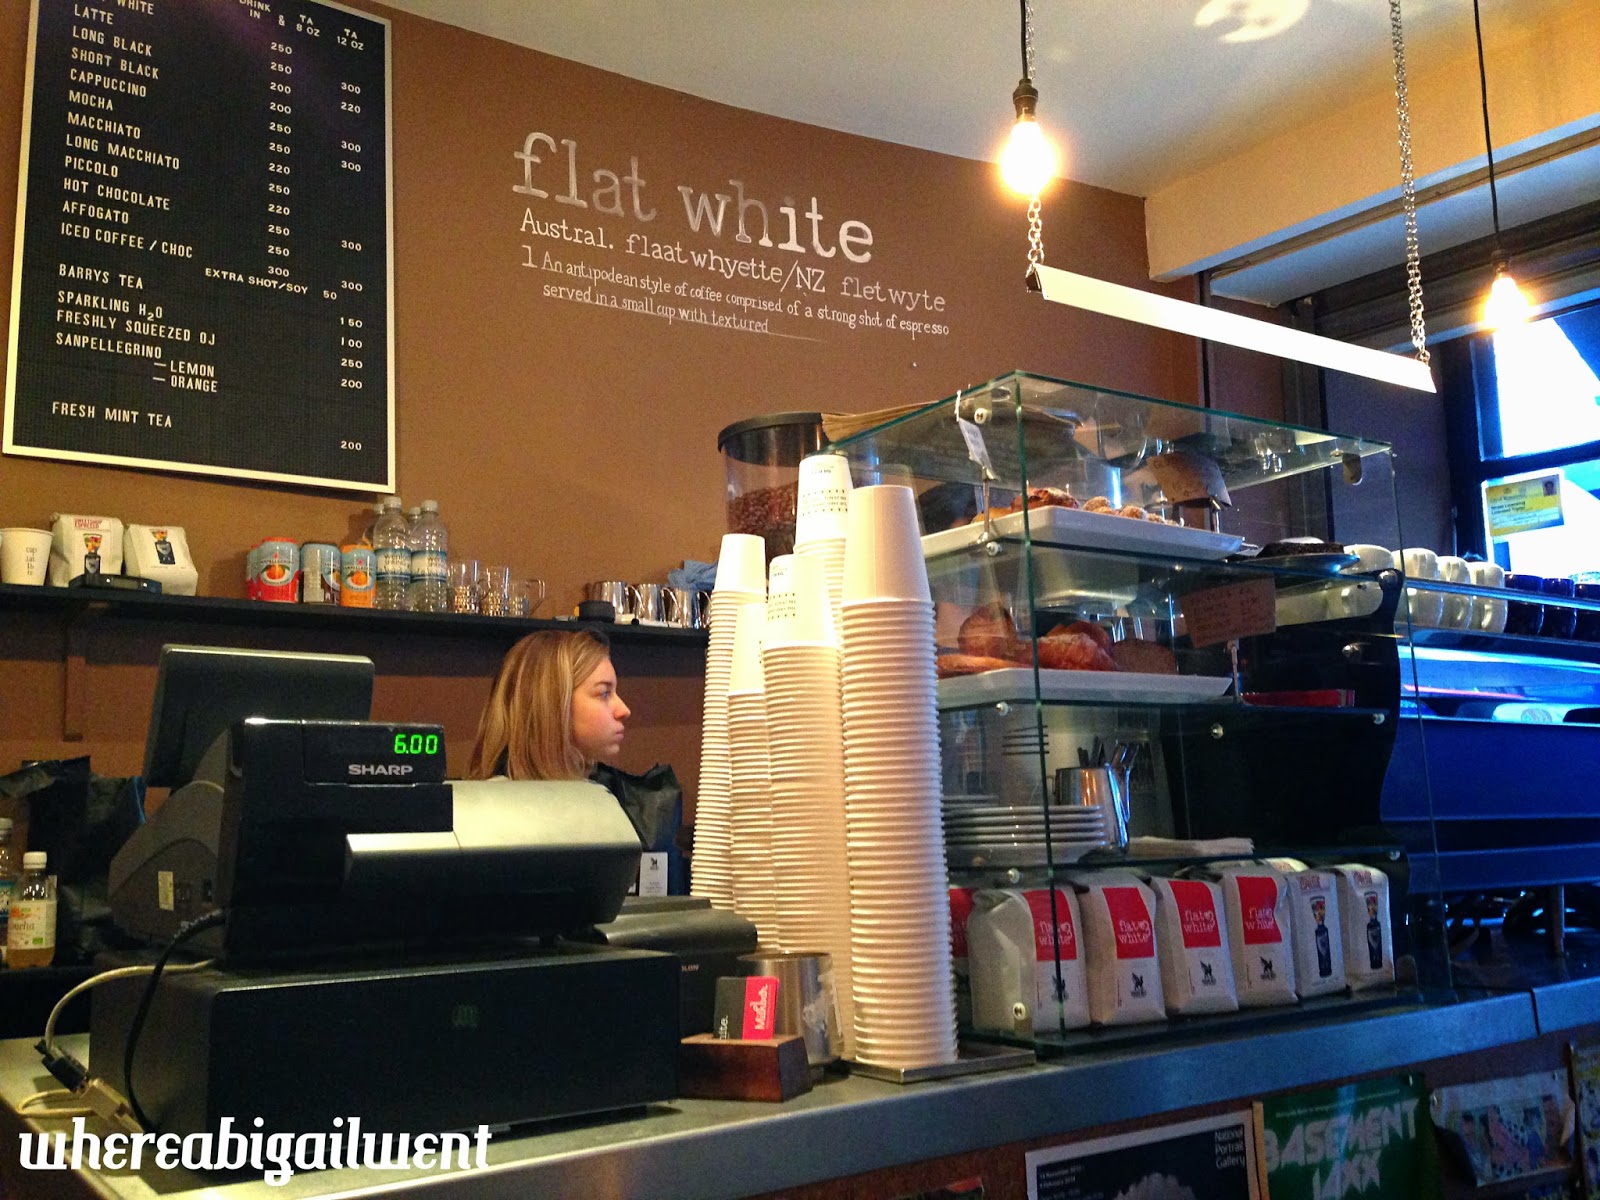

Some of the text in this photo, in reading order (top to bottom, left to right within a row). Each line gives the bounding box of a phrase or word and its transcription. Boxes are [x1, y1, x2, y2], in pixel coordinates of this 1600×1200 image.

[118, 0, 154, 15] WHITE
[239, 0, 270, 13] DRINK
[75, 4, 113, 24] LATTE
[250, 9, 285, 26] IN &
[299, 14, 313, 26] TA
[296, 23, 320, 36] 8 OZ
[343, 29, 357, 40] TA
[73, 26, 151, 56] LONG BLACK
[337, 36, 363, 50] 12 OZ
[271, 42, 292, 54] 250
[72, 47, 158, 79] SHORT BLACK
[271, 62, 292, 74] 250
[69, 68, 147, 98] CAPPUCCINO
[270, 82, 291, 94] 200
[341, 82, 360, 94] 300
[69, 90, 113, 110] MOCHA
[270, 102, 291, 114] 200
[341, 102, 360, 113] 220
[67, 112, 140, 140] MACCHIATO
[270, 122, 291, 134] 250
[66, 134, 179, 171] LONG MACCHIATO
[270, 143, 290, 154] 250
[341, 141, 361, 152] 300
[65, 156, 118, 177] PICCOLO
[269, 163, 290, 174] 220
[341, 161, 361, 172] 300
[64, 178, 169, 211] HOT CHOCOLATE
[269, 183, 290, 195] 250
[512, 132, 874, 263] flat white
[62, 201, 128, 225] AFFOGATO
[268, 204, 290, 215] 220
[268, 225, 289, 236] 250
[61, 222, 192, 258] ICED COFFEE / CHOC
[342, 240, 361, 251] 300
[268, 245, 289, 256] 250
[520, 208, 614, 250] Austral.
[626, 234, 688, 264] flaat
[840, 277, 885, 303] flet
[888, 288, 946, 313] wyte
[59, 264, 143, 289] BARRYS TEA
[268, 266, 289, 277] 300
[206, 268, 243, 282] EXTRA
[324, 290, 337, 300] 50
[342, 281, 362, 291] 300
[57, 291, 129, 314] SPARKLING
[541, 251, 563, 273] An
[566, 258, 638, 288] antipodean
[639, 272, 671, 295] style
[675, 282, 688, 296] of
[690, 283, 722, 303] coffee
[726, 292, 782, 313] comprised
[787, 300, 800, 316] of
[804, 306, 813, 318] a
[818, 308, 856, 330] strong
[859, 308, 882, 326] shot
[886, 313, 897, 329] of
[900, 317, 950, 344] espresso
[542, 282, 769, 333] served in a small cup with textured
[57, 310, 215, 345] FRESHLY SQUEEZED OJ
[56, 332, 163, 359] SANPELLEGRINO
[171, 360, 214, 378] LEMON
[341, 358, 362, 368] 250
[171, 374, 217, 392] ORANGE
[341, 379, 362, 389] 200
[53, 402, 171, 427] FRESH MINT TEA
[341, 441, 361, 450] 200
[394, 734, 438, 754] 6.00
[348, 764, 413, 776] SHARP
[1183, 921, 1215, 933] white
[1117, 932, 1150, 945] white
[1216, 1154, 1246, 1170] Gallery
